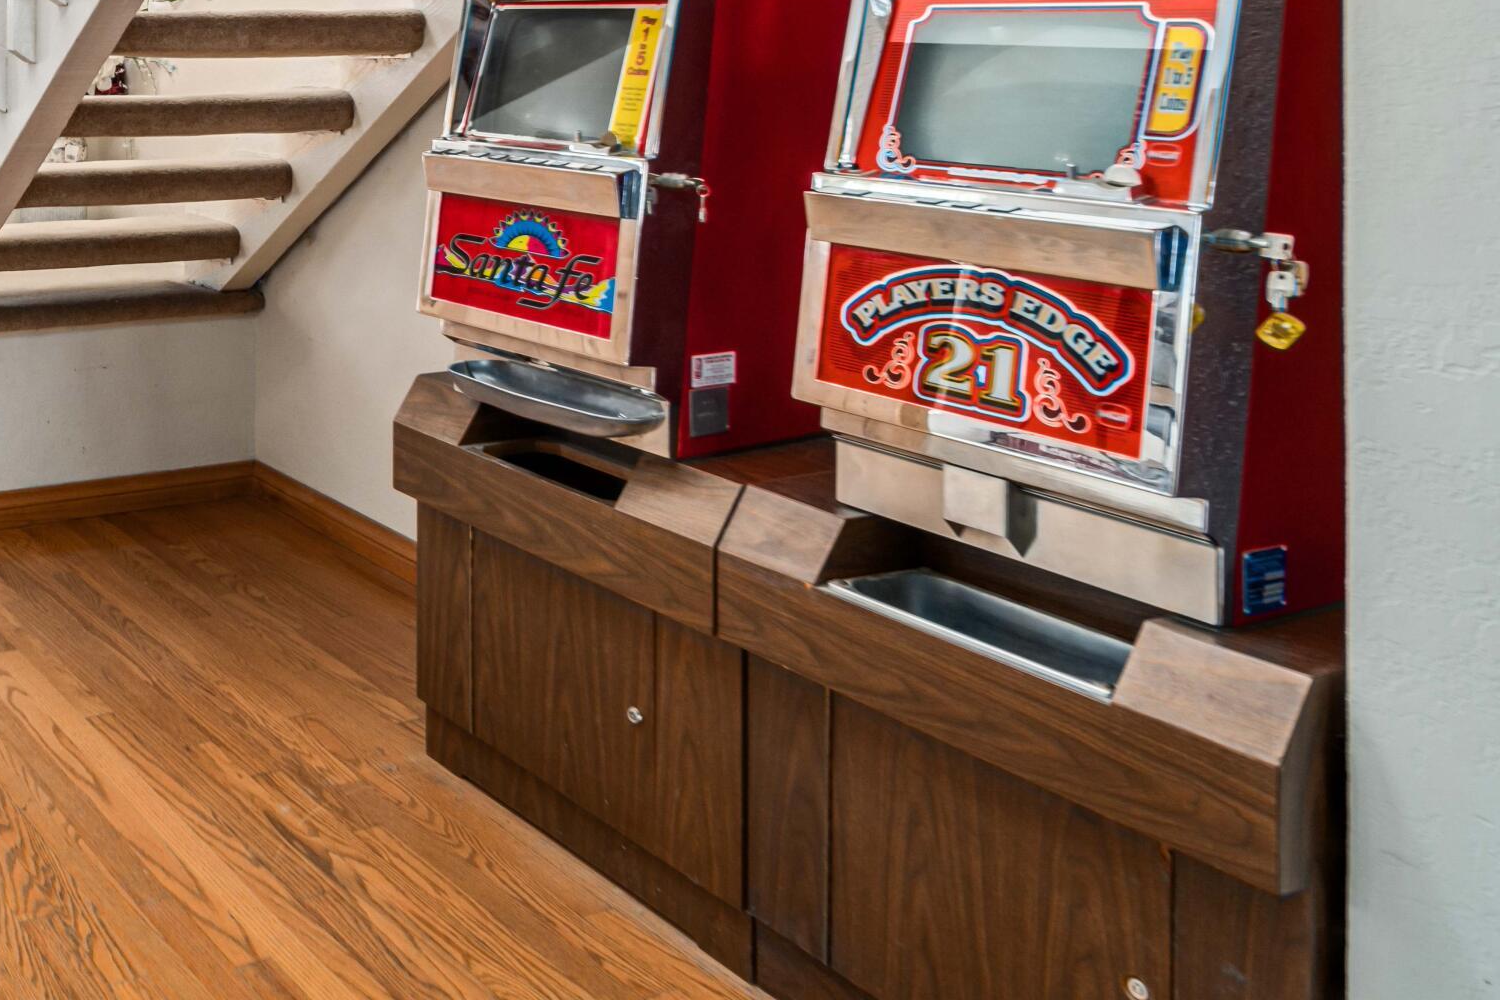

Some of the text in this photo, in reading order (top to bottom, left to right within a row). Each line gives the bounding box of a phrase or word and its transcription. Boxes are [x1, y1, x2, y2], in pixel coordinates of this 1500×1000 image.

[435, 232, 549, 292] Santa
[851, 277, 1119, 382] PLAYERS EDGE
[924, 331, 1019, 412] 21
